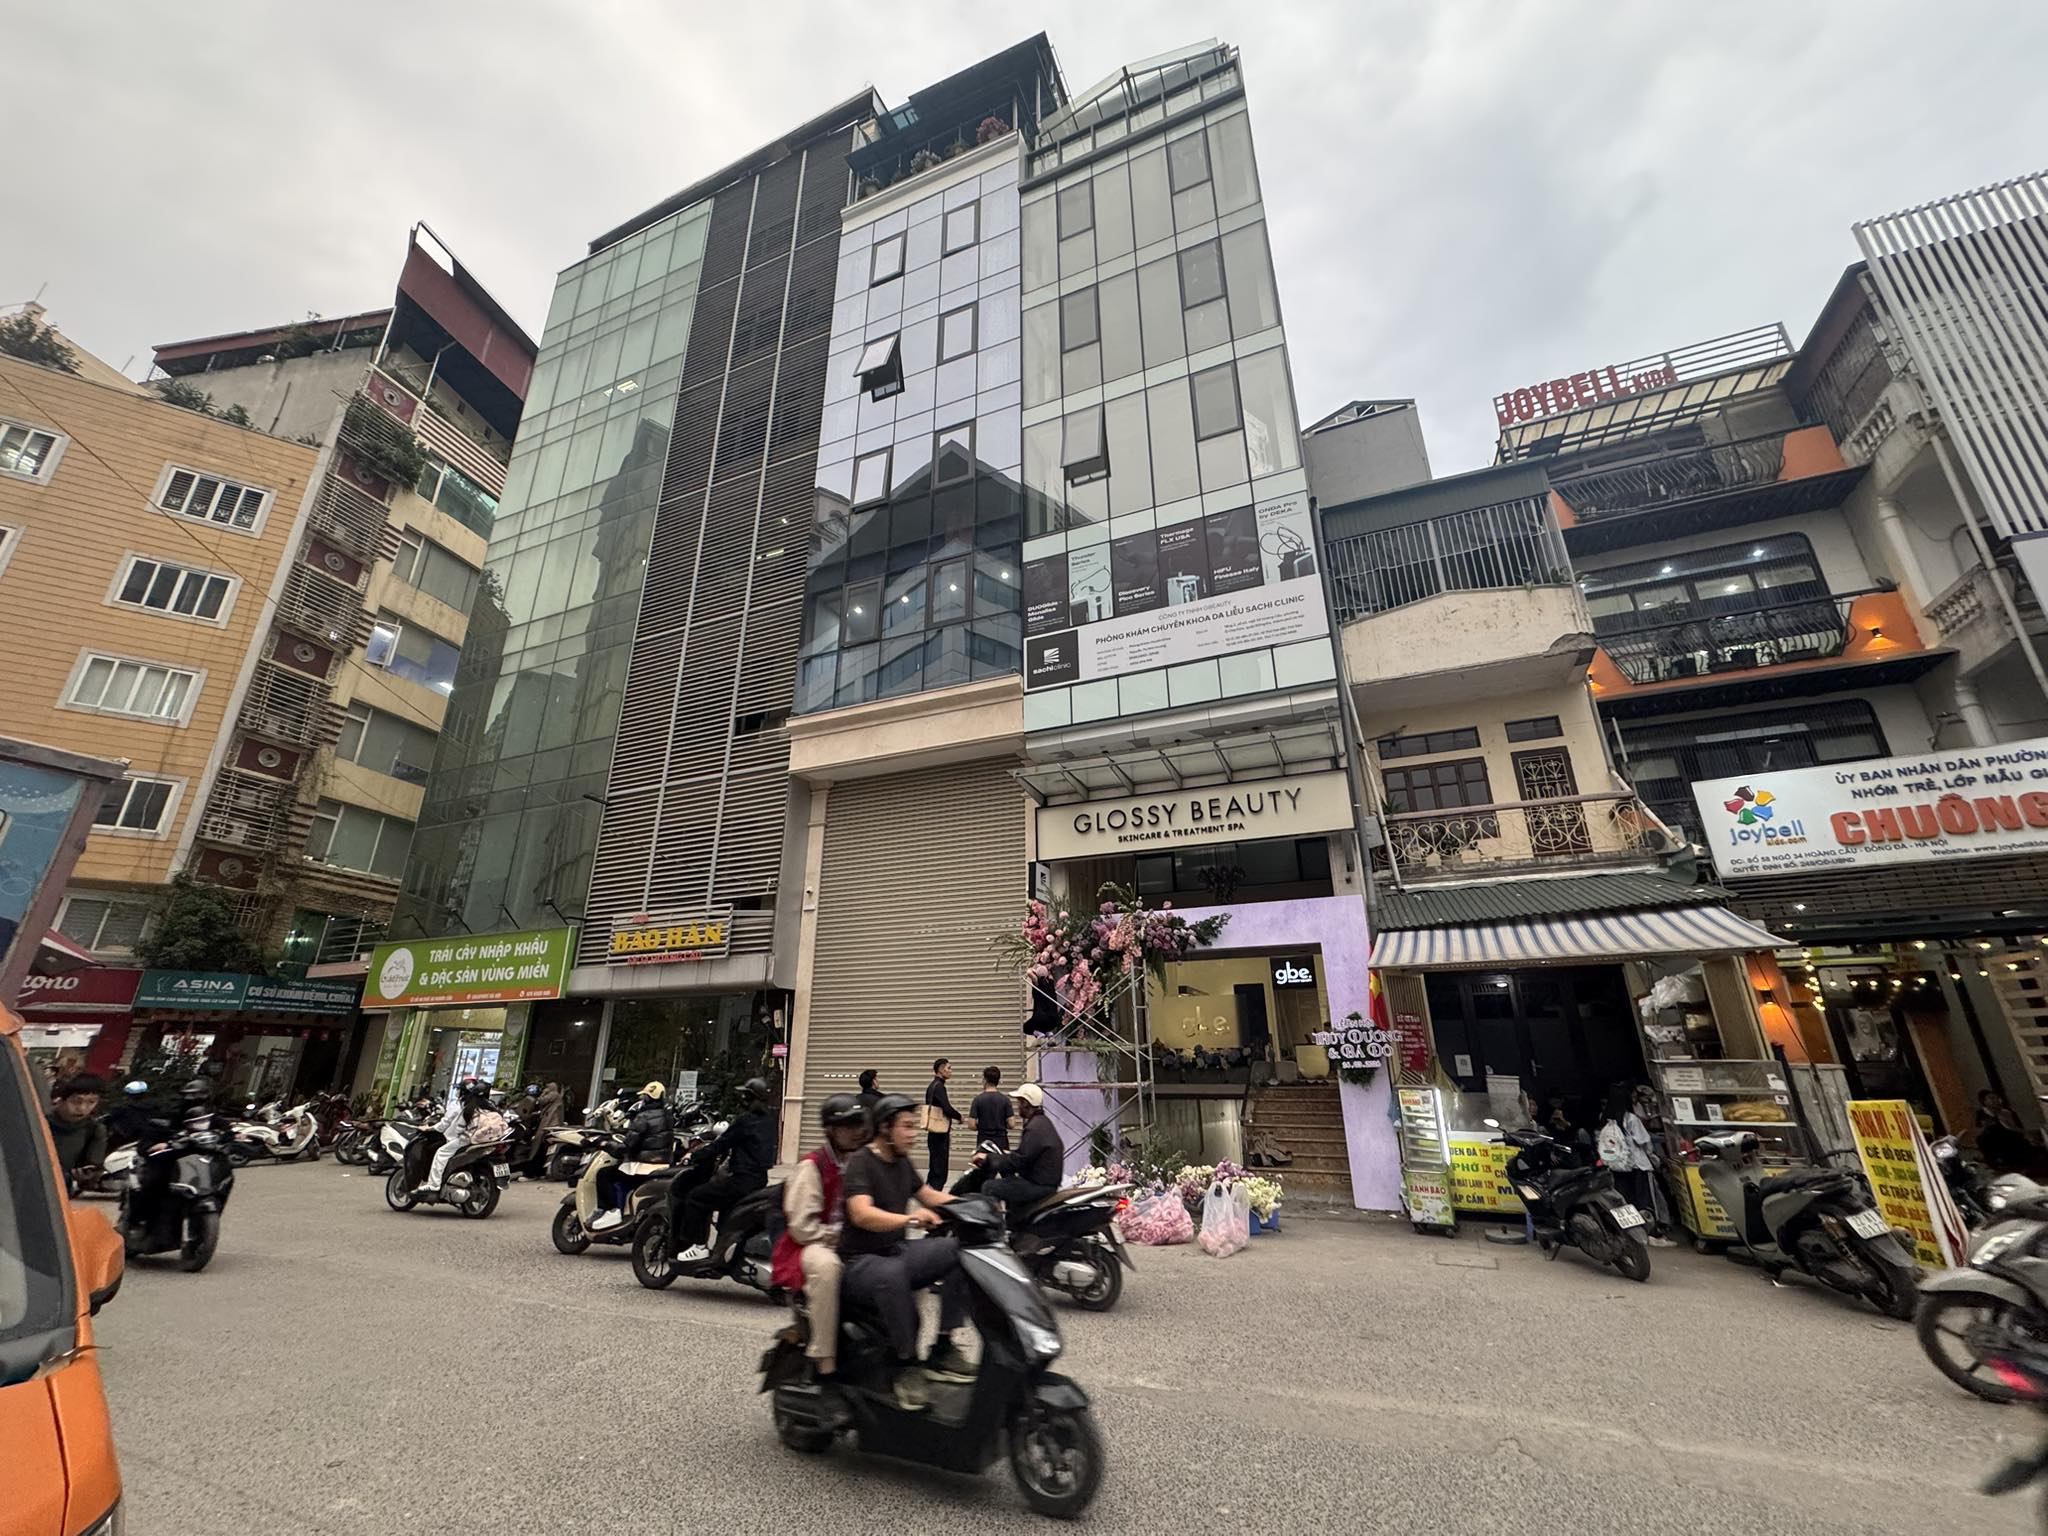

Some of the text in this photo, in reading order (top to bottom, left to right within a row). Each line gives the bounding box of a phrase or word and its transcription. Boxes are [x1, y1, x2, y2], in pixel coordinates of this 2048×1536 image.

[1500, 365, 1632, 426] JOYBELL
[1258, 505, 1282, 514] ONDA
[1270, 507, 1293, 517] DEKA
[1176, 533, 1191, 541] USA
[1095, 594, 1306, 645] PHÒNG KHÁM CHUYÊN KHOA DA LIỄU SACHI CLINIC
[1835, 749, 2048, 785] ỦY BAN NHÂN DÂN PHƯỜN
[1851, 784, 1899, 799] NHÓM
[1944, 773, 1978, 790] LỚP
[1983, 768, 2023, 785] MẪU
[2029, 768, 2048, 780] GI
[1073, 787, 1302, 834] GLOSSY BEAUTY
[1118, 822, 1246, 843] SKINCARE & TREATMENT SPA
[1730, 819, 1806, 846] joybell
[1766, 837, 1807, 847] kids.com
[1804, 849, 1837, 858] HOÀNG
[1915, 839, 1929, 848] HÀ
[1930, 839, 1949, 847] NỘI
[429, 934, 549, 963] TRÁI CÂY NHẬP KHẨU
[611, 928, 662, 955] BAO
[172, 979, 236, 990] ASINA
[419, 957, 550, 989] & ĐẶC SẢN VÙNG MIỀN
[1275, 961, 1313, 985] gbe.
[1328, 1047, 1341, 1059] &
